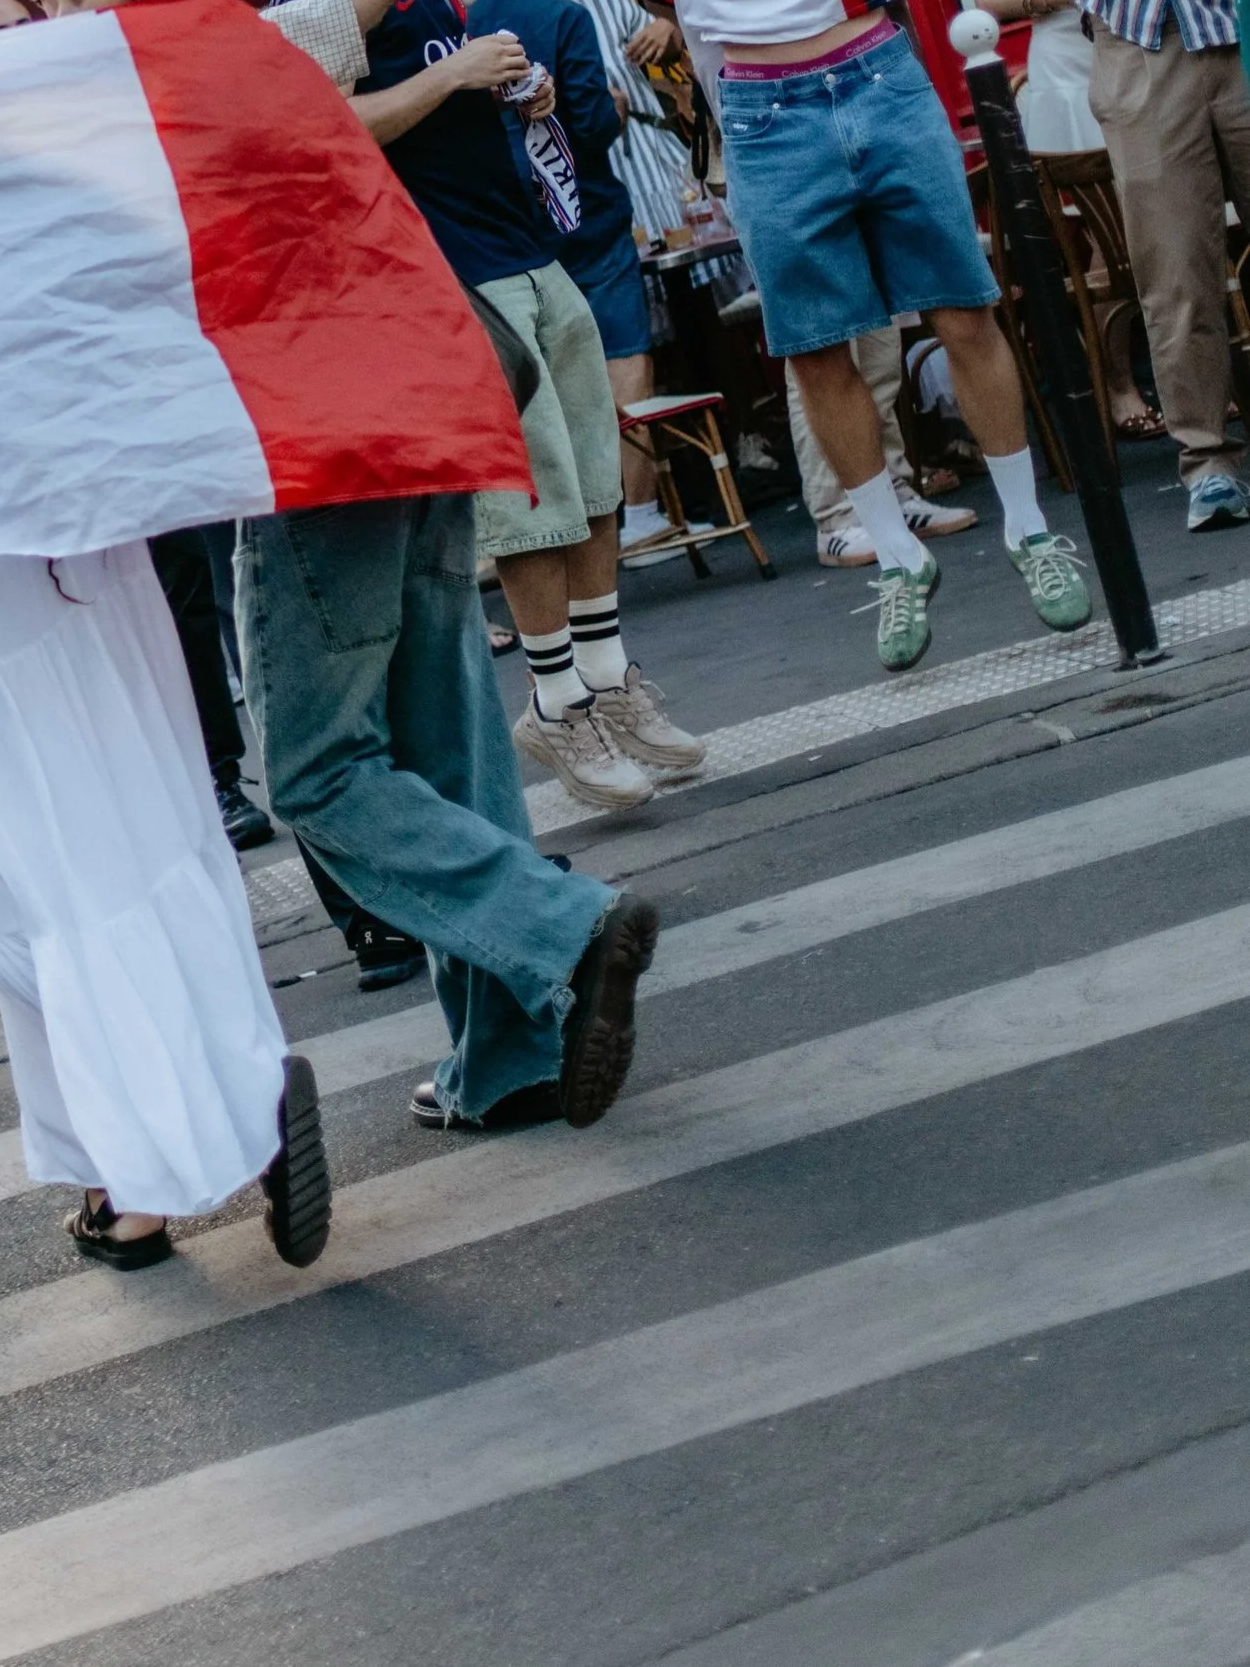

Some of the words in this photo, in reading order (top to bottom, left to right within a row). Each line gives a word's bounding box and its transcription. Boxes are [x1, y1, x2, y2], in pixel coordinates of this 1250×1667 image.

[845, 40, 871, 58] Calvin
[871, 31, 887, 44] Klein
[746, 70, 765, 79] Klein
